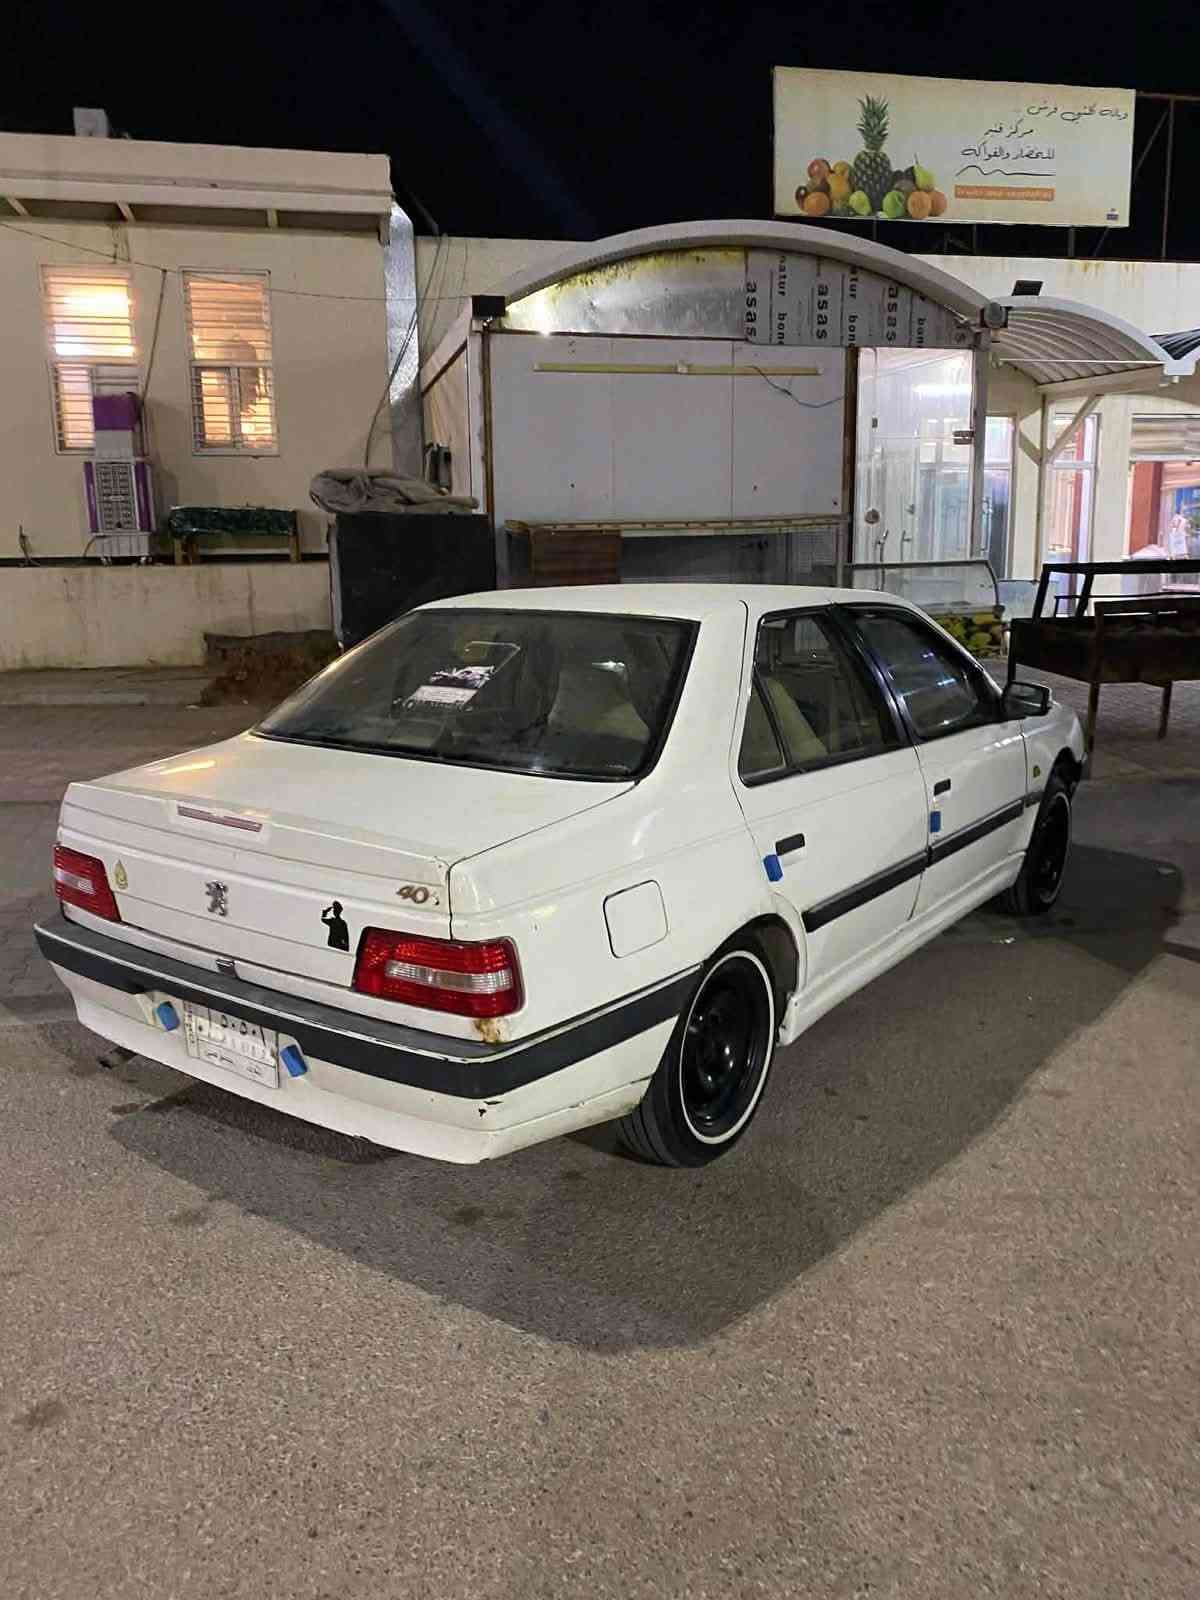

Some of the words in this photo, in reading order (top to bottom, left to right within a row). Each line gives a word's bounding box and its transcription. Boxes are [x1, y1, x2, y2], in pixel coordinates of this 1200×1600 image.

[1005, 118, 1034, 138] مركز
[745, 280, 757, 337] asas
[816, 284, 829, 340] asas
[886, 287, 898, 342] asas
